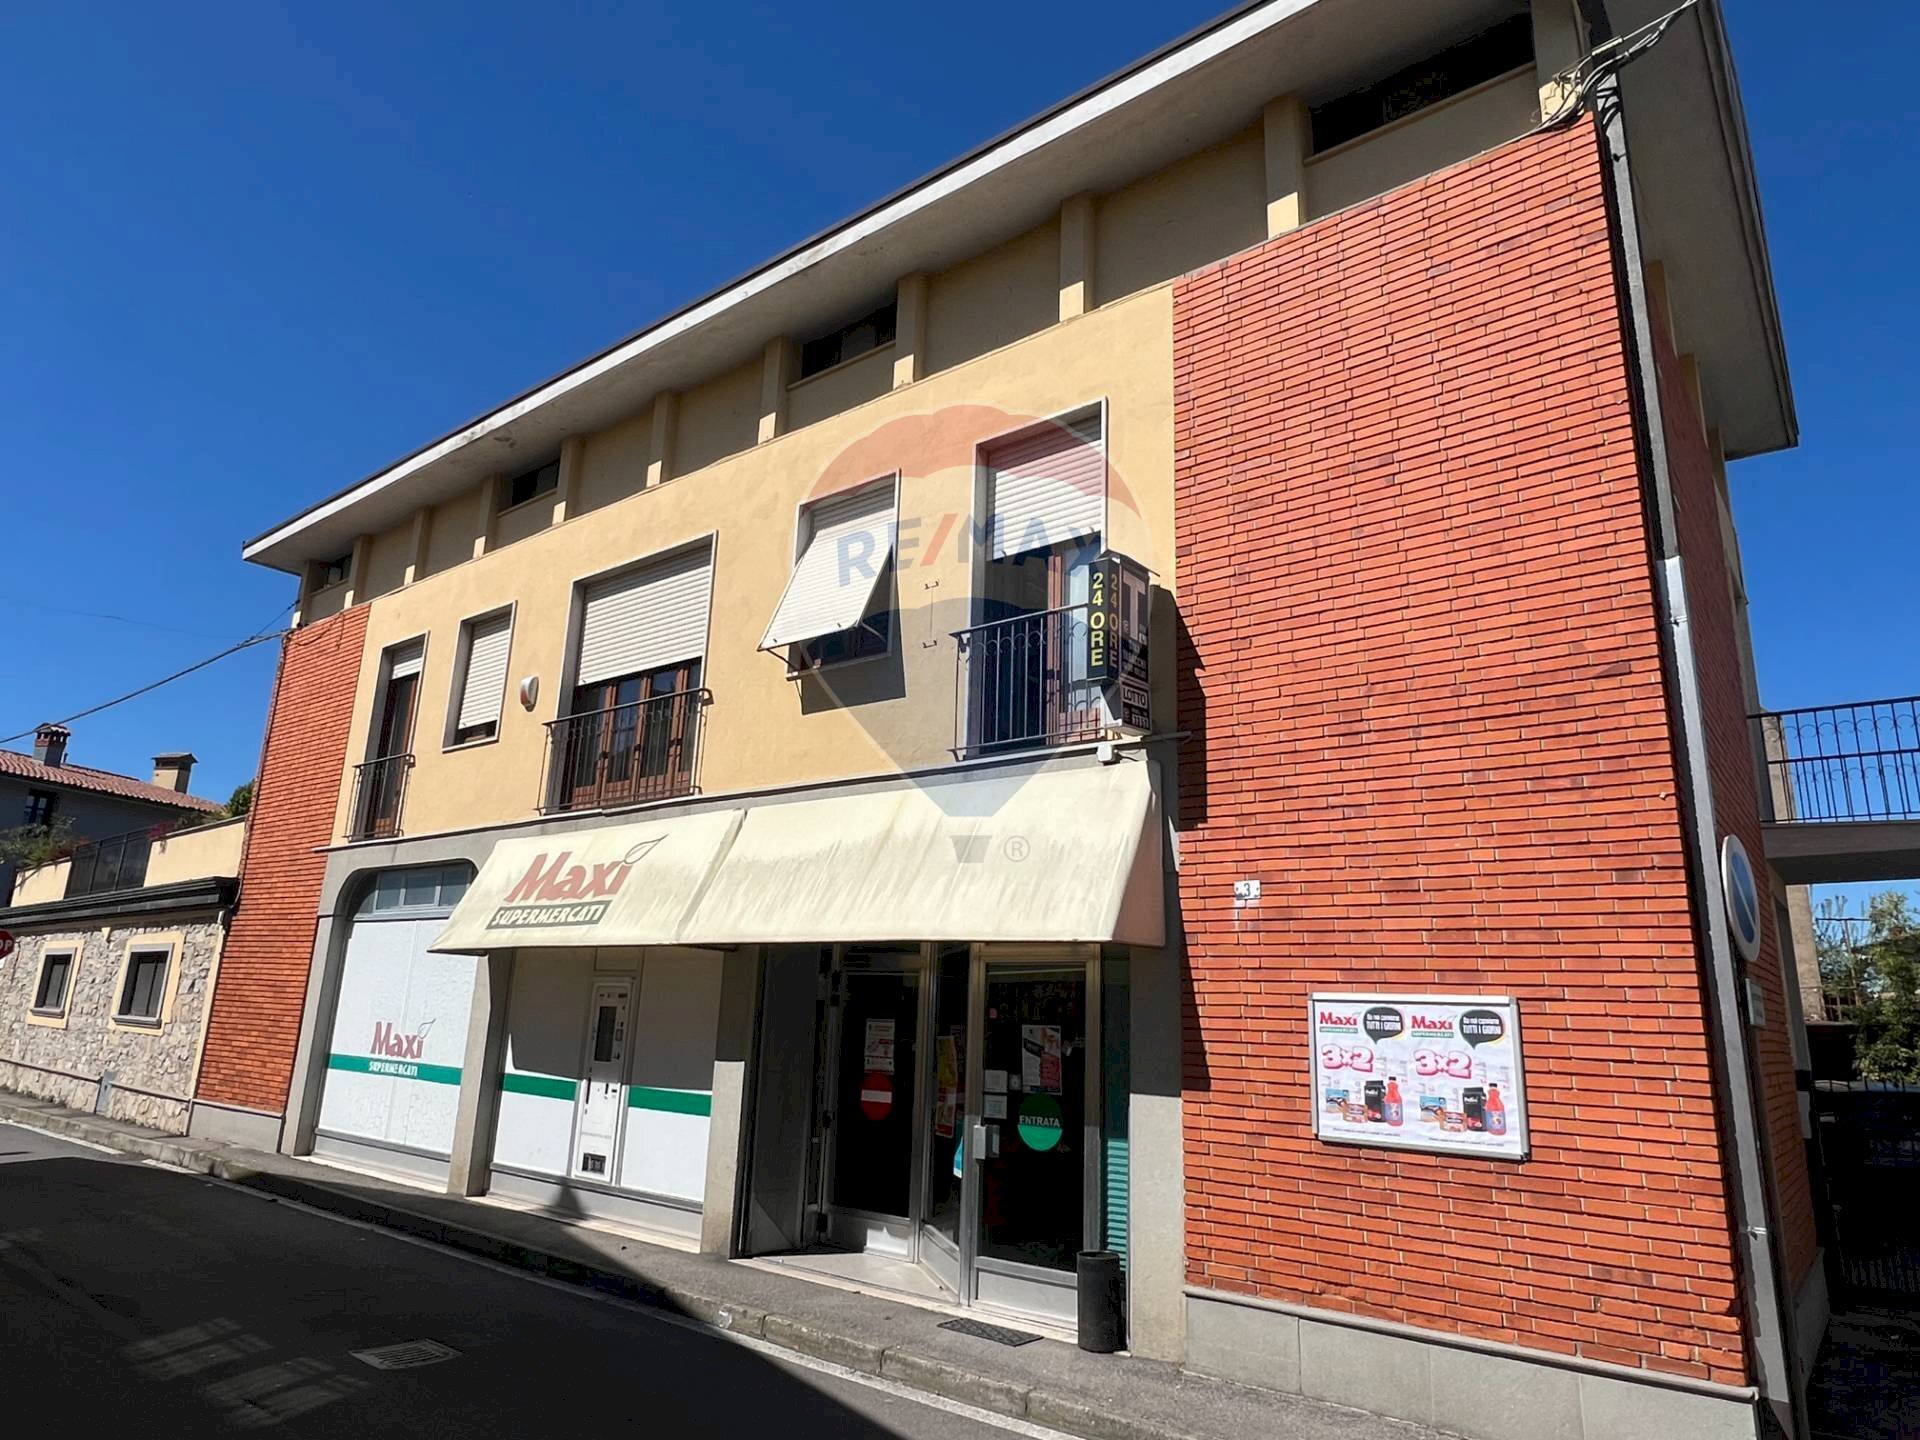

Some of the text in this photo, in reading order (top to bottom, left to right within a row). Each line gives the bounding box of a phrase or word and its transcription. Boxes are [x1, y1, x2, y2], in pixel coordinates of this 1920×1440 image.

[1090, 572, 1105, 667] 24 ORE
[1109, 613, 1119, 669] ORE
[1123, 687, 1147, 707] LOTTO
[503, 850, 634, 903] Maxi
[490, 903, 606, 926] SUPERMERCATI
[1320, 1011, 1358, 1026] Maxi
[1411, 1015, 1453, 1030] Maxi
[370, 1021, 424, 1059] Maxi
[368, 1061, 418, 1077] SUPERMERCATI
[1321, 1043, 1374, 1073] 3x2
[1413, 1048, 1472, 1079] 3x2
[1019, 1115, 1061, 1128] ENTRATA
